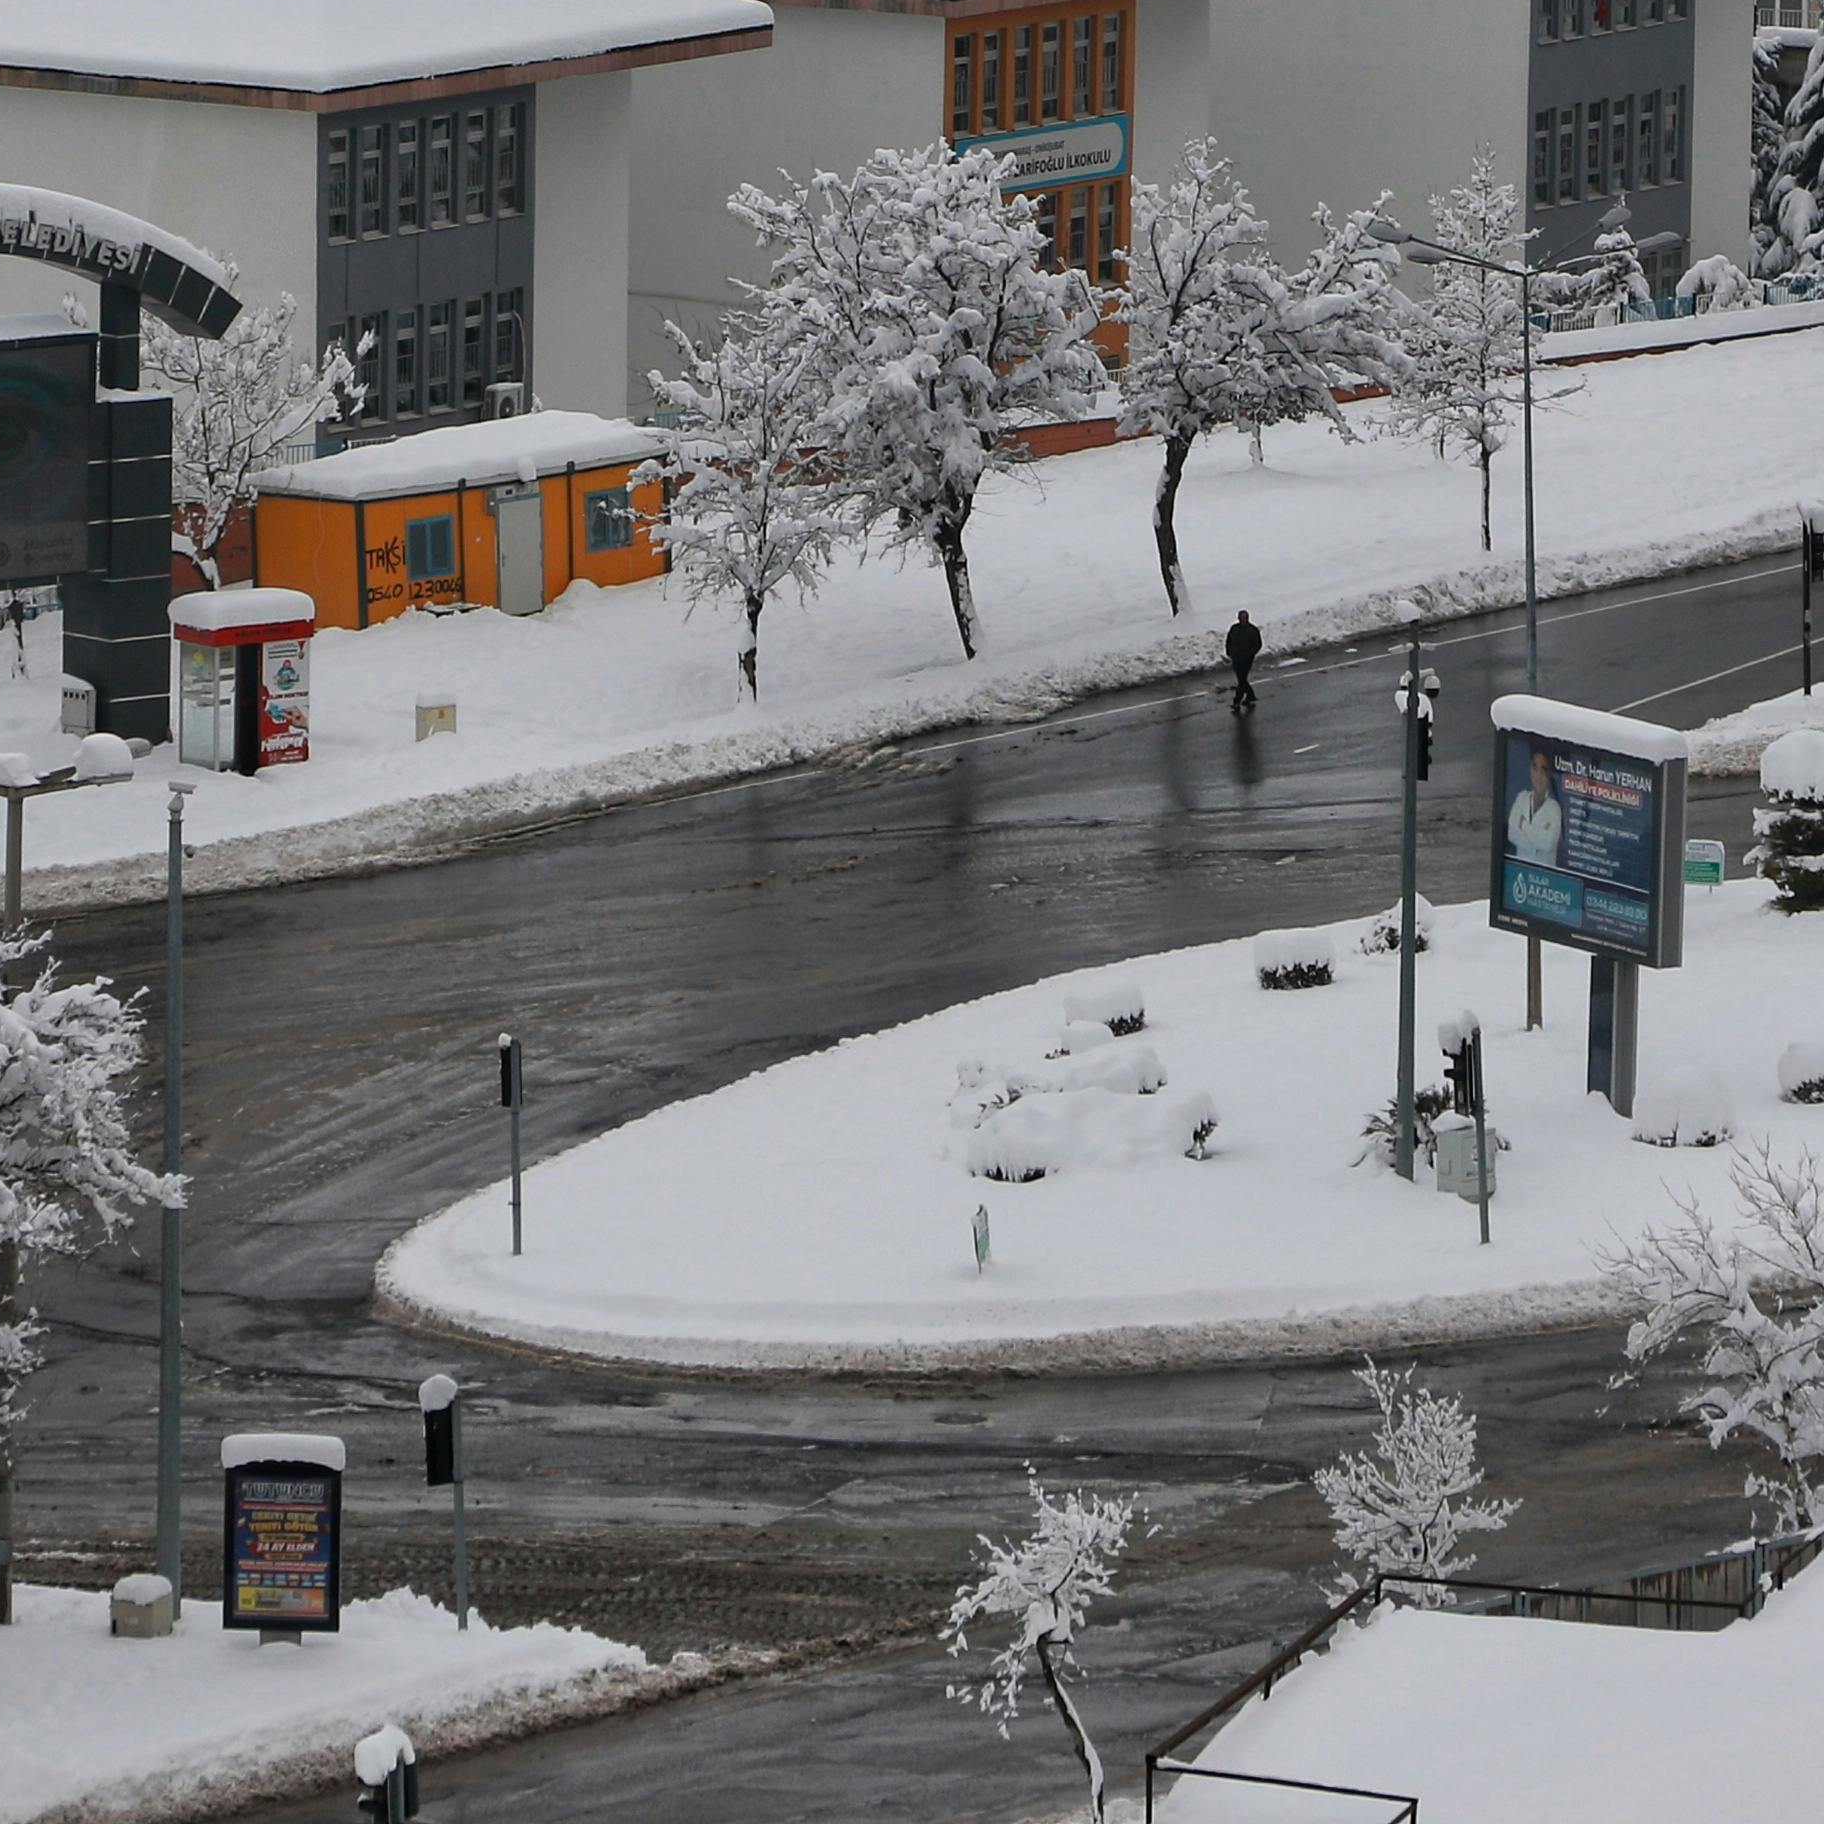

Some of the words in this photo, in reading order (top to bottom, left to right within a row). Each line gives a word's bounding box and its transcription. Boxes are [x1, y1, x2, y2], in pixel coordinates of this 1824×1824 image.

[1065, 148, 1112, 170] İLKOKULU
[367, 582, 404, 604] 0540
[1575, 761, 1588, 777] Dr.
[1588, 763, 1615, 784] Harun
[1614, 770, 1653, 793] YERHAN
[1527, 883, 1571, 906] AKADEMİ
[270, 1542, 286, 1552] AY
